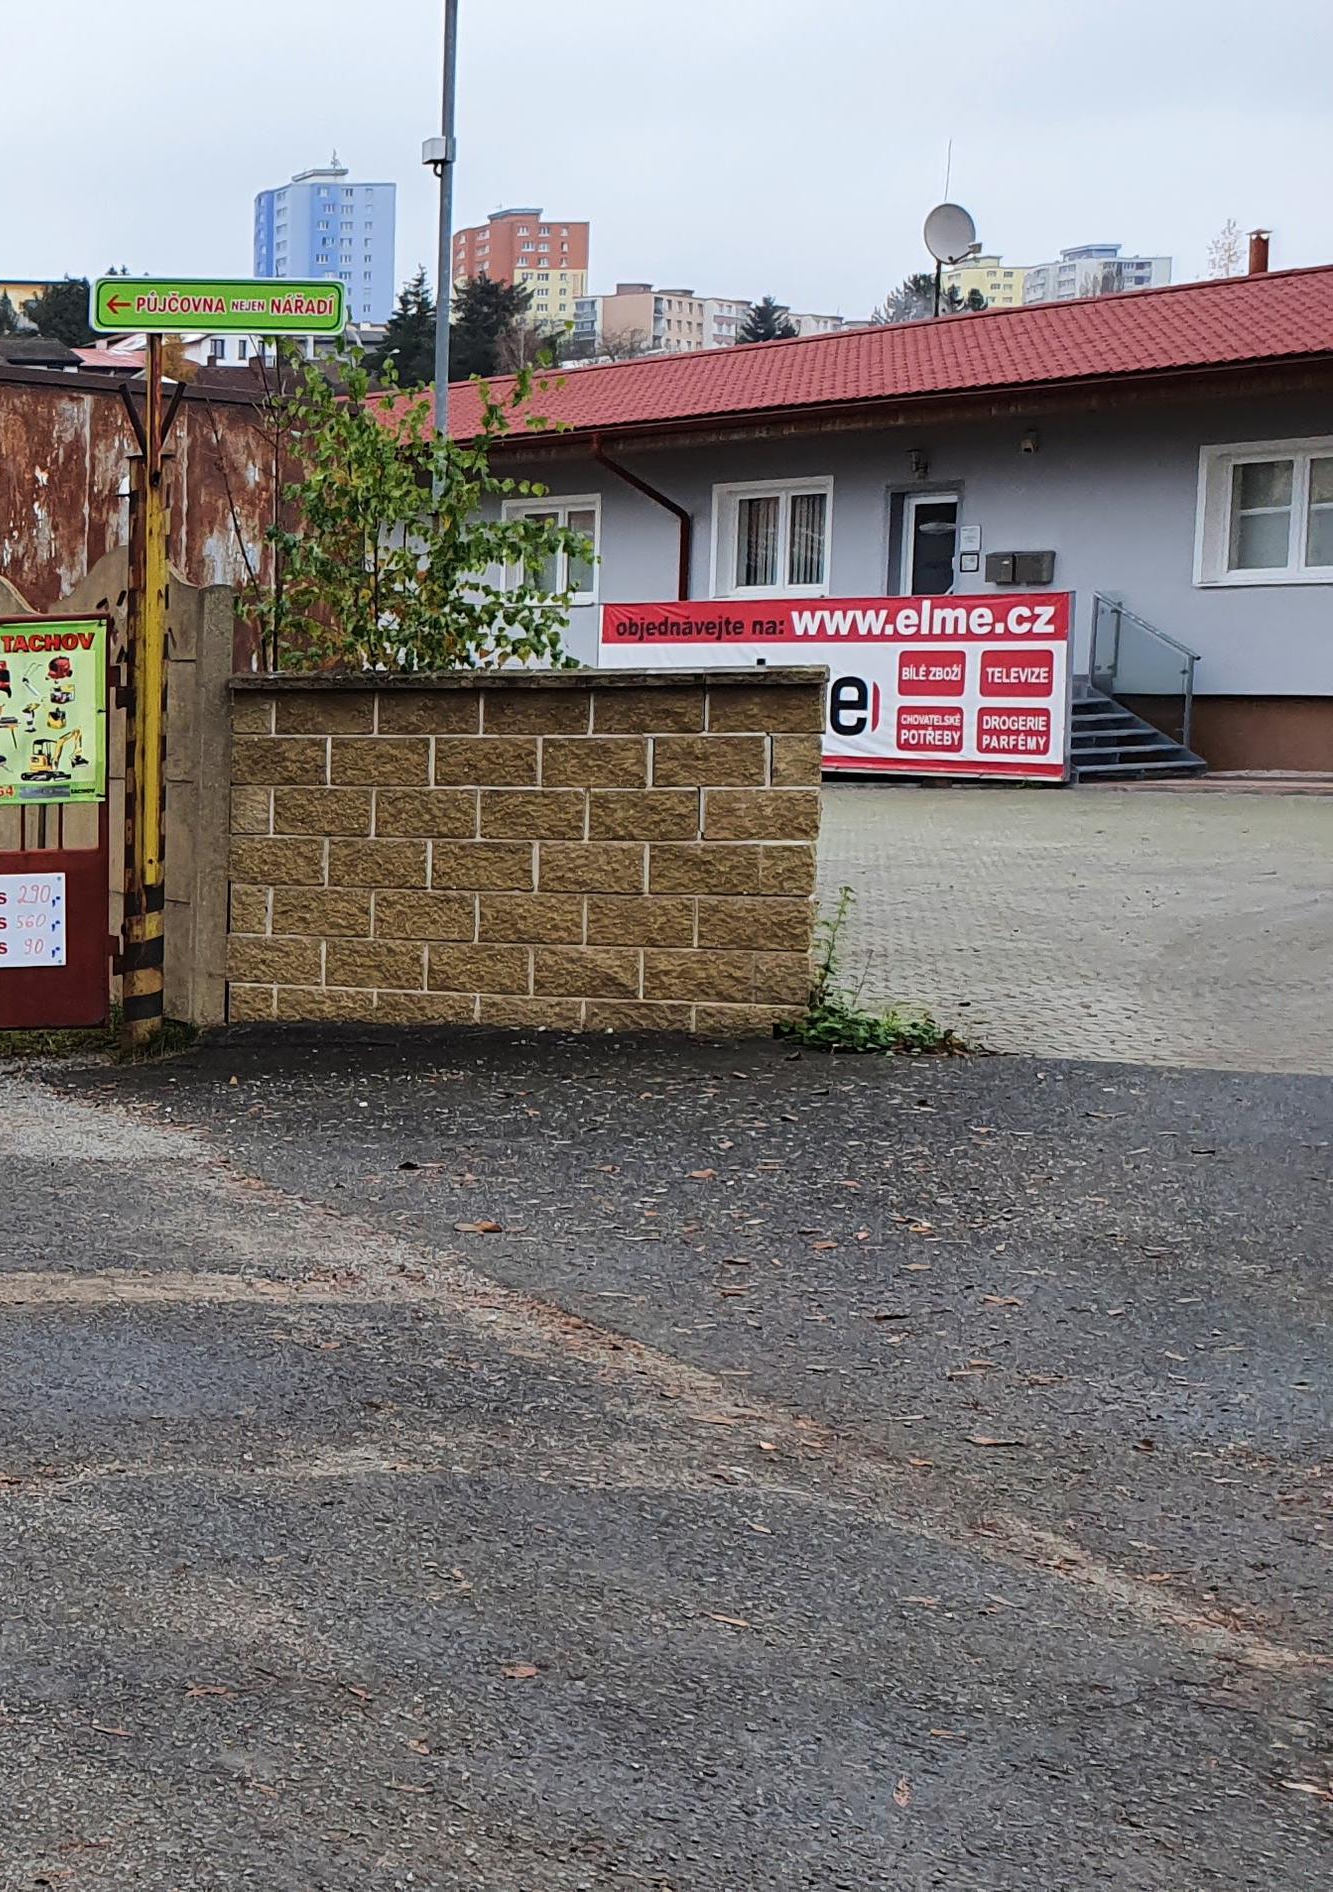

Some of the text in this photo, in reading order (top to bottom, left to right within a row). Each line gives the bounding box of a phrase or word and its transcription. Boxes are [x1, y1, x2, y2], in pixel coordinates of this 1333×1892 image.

[136, 291, 335, 315] PŮJČOVNA NEJEN NÁŘADÍ
[616, 600, 1056, 640] objednávejte na: www.elme.cz
[0, 633, 96, 653] TACHOV
[901, 664, 962, 681] BÍLÉ ZBOŽÍ
[985, 667, 1050, 683] TELEVIZE
[900, 713, 962, 726] CHOVATELSKÉ
[982, 715, 1048, 731] DROGERIE
[900, 728, 961, 746] POTŘEBY
[982, 734, 1047, 751] PARFÉMY
